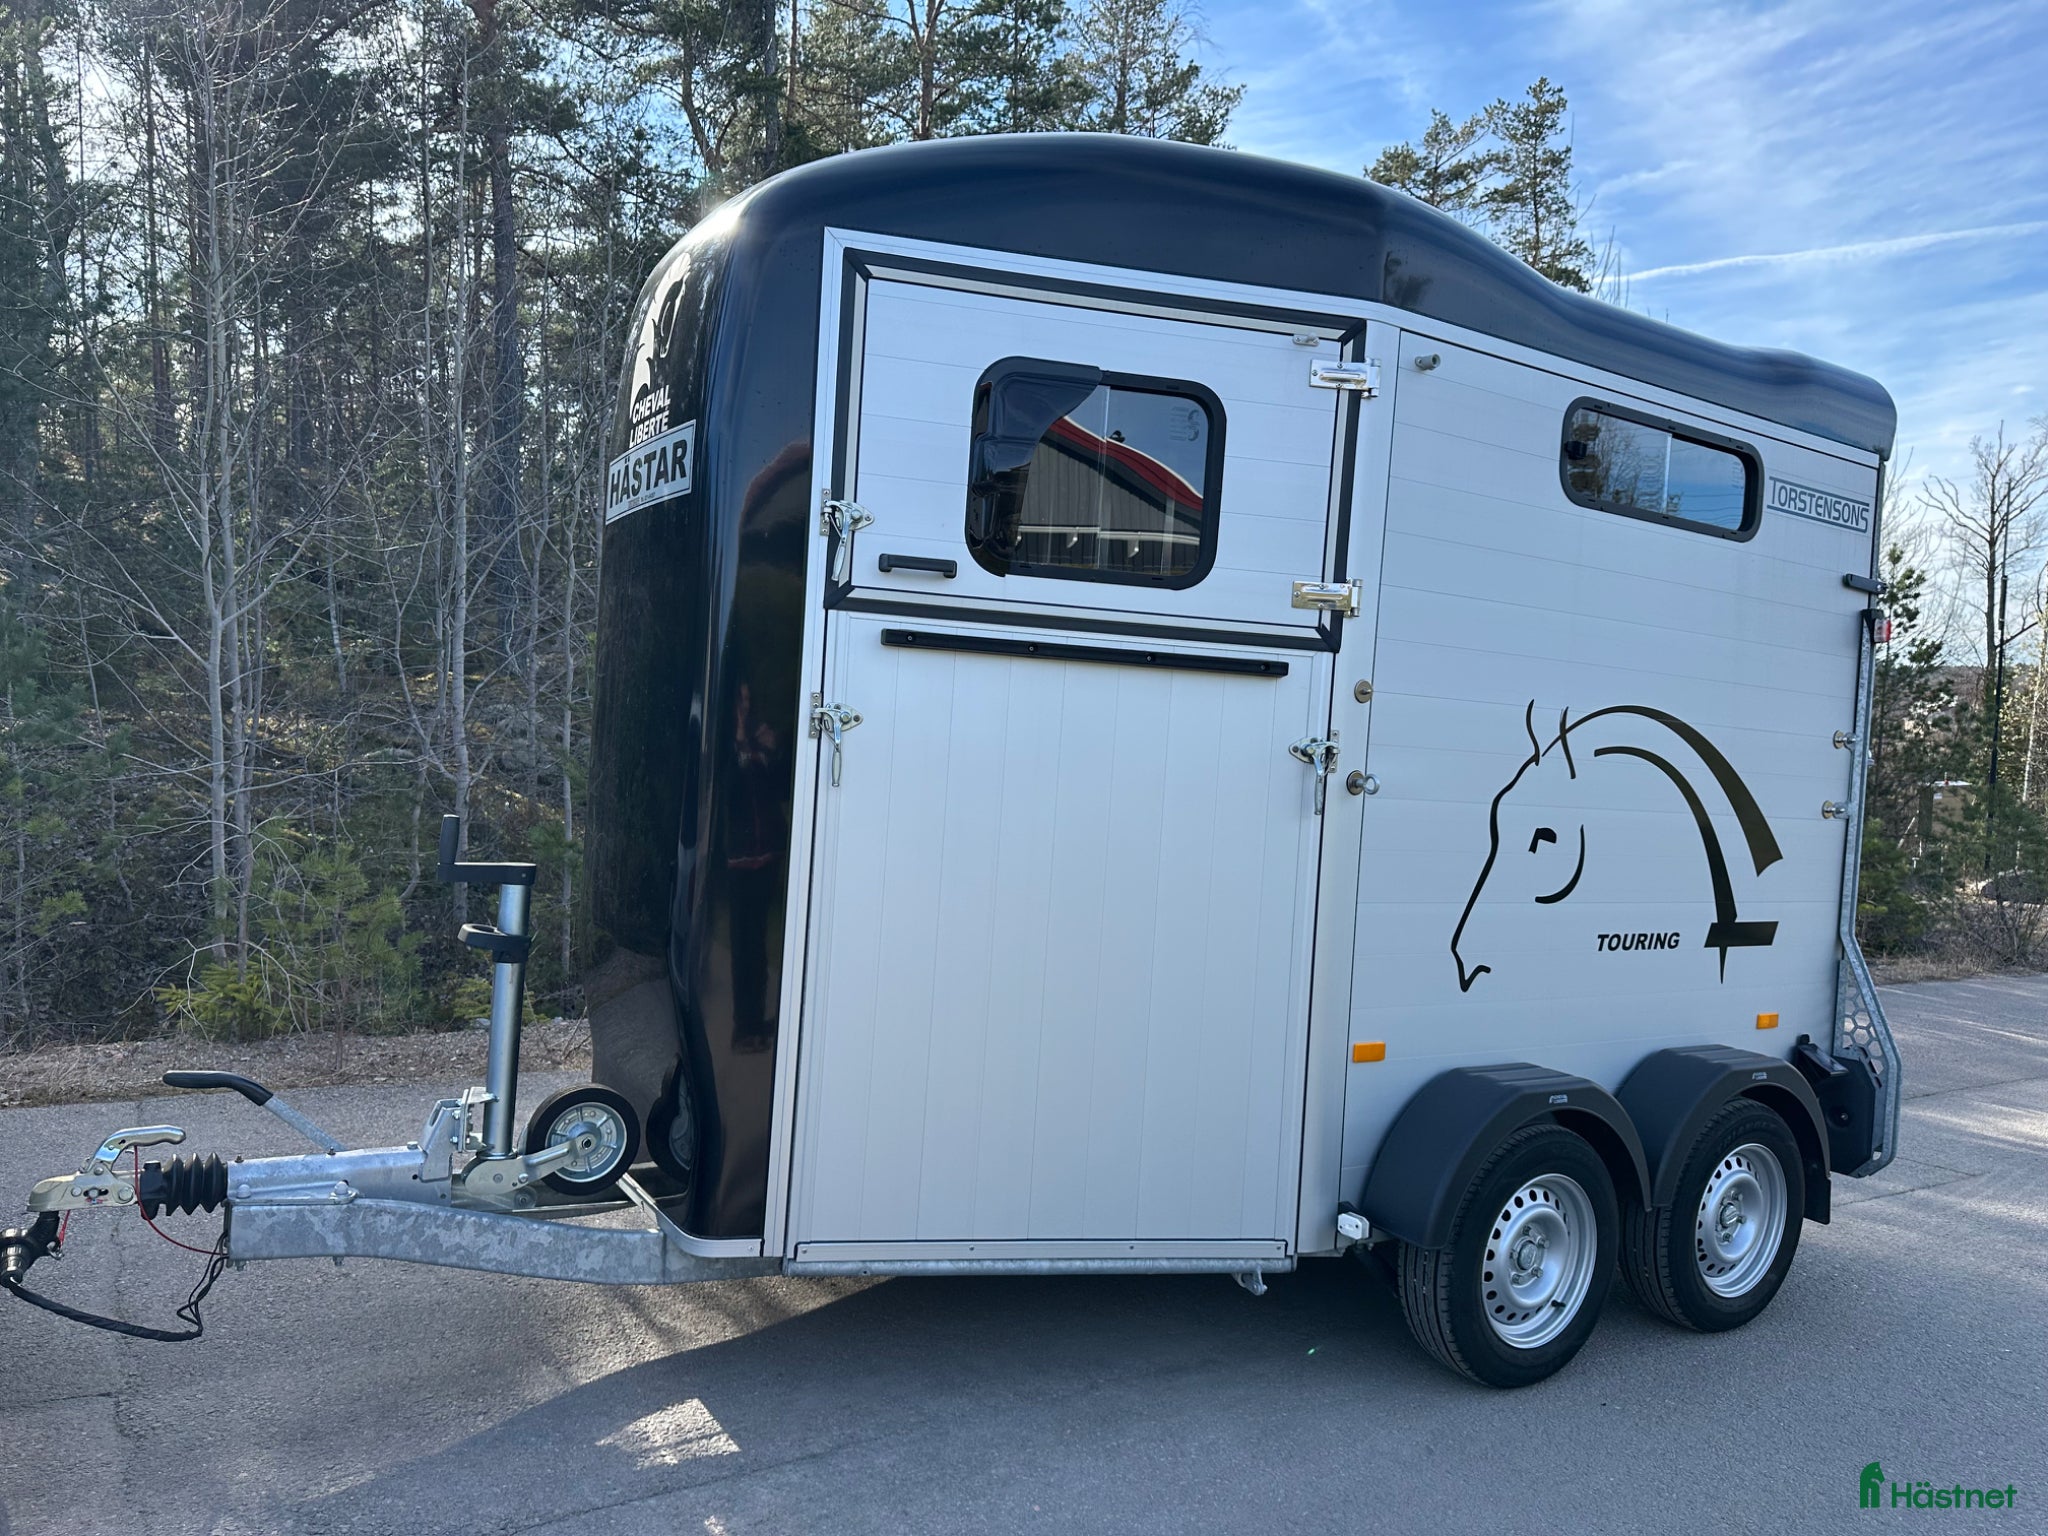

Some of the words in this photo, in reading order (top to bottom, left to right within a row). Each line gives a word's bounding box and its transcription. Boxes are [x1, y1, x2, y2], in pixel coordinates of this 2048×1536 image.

[632, 384, 671, 424] CHEVAL
[609, 439, 688, 509] HÄSTAR
[1766, 476, 1870, 533] TORSTENSONS
[1597, 932, 1681, 951] TOURING
